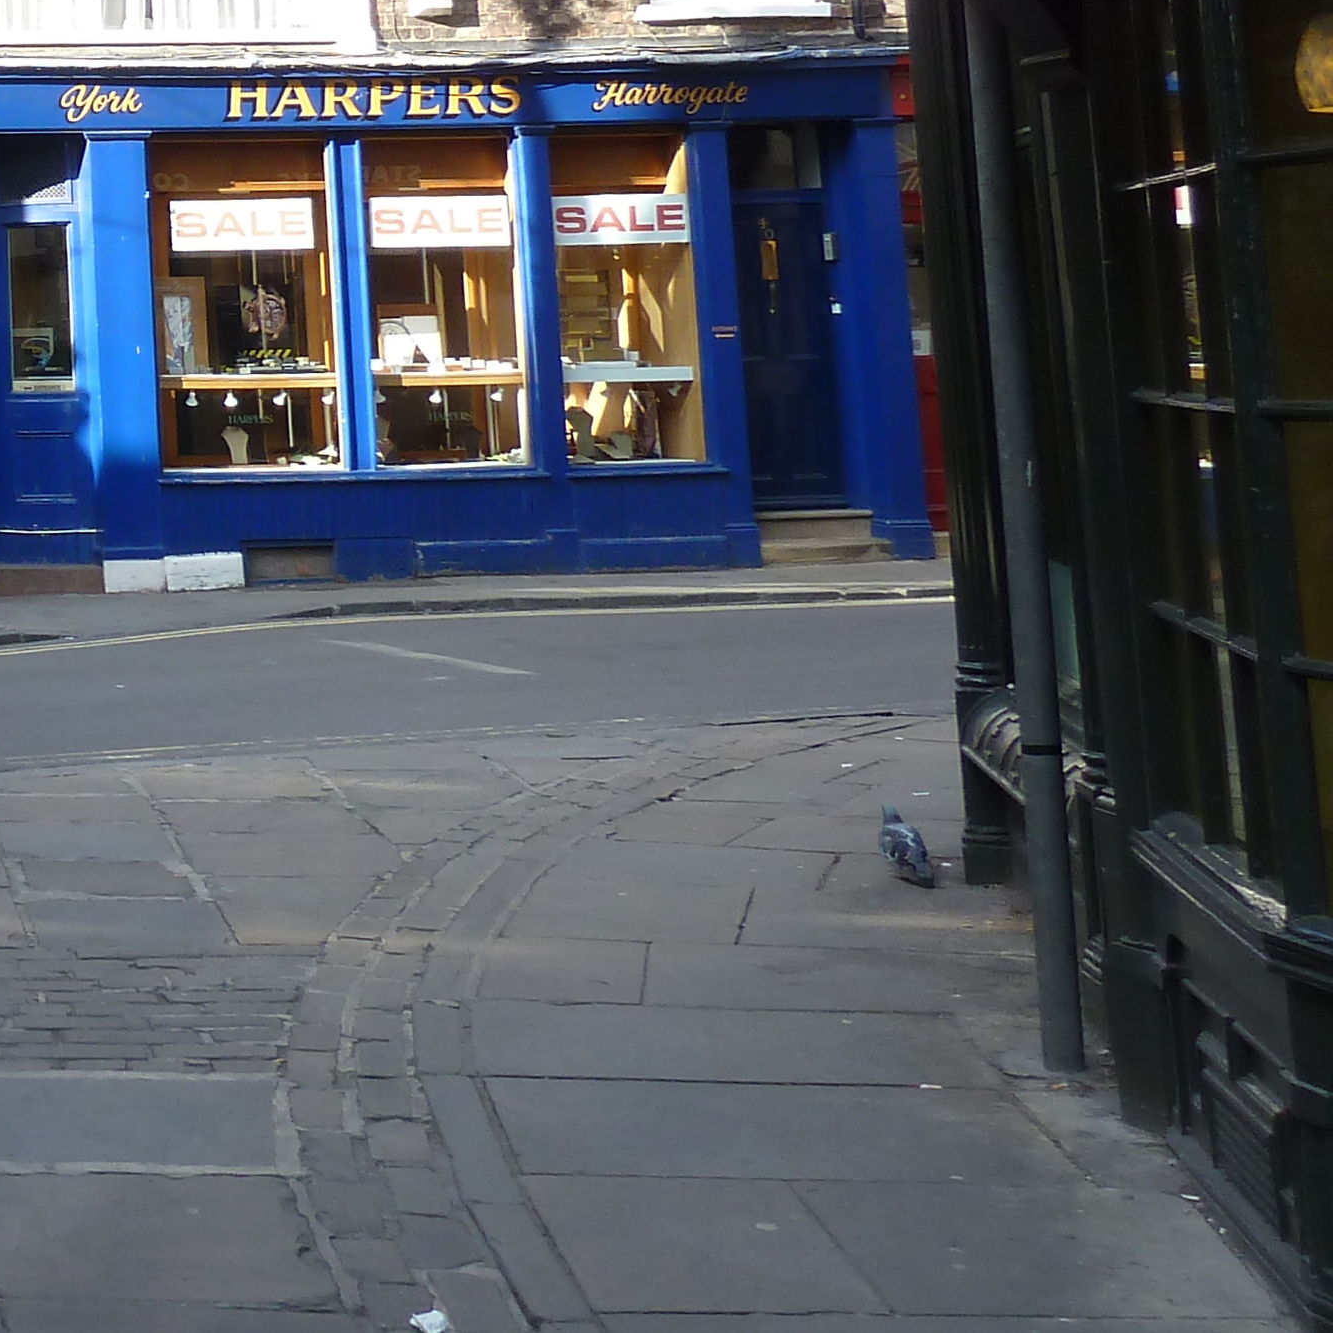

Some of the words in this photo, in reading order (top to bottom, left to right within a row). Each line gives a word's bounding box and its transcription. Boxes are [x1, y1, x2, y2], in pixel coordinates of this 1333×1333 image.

[60, 84, 143, 123] York
[223, 75, 522, 122] HARPERS
[592, 80, 749, 117] Harrogate
[175, 209, 308, 239] SALE
[374, 206, 503, 235] SALE
[554, 203, 686, 233] SALE
